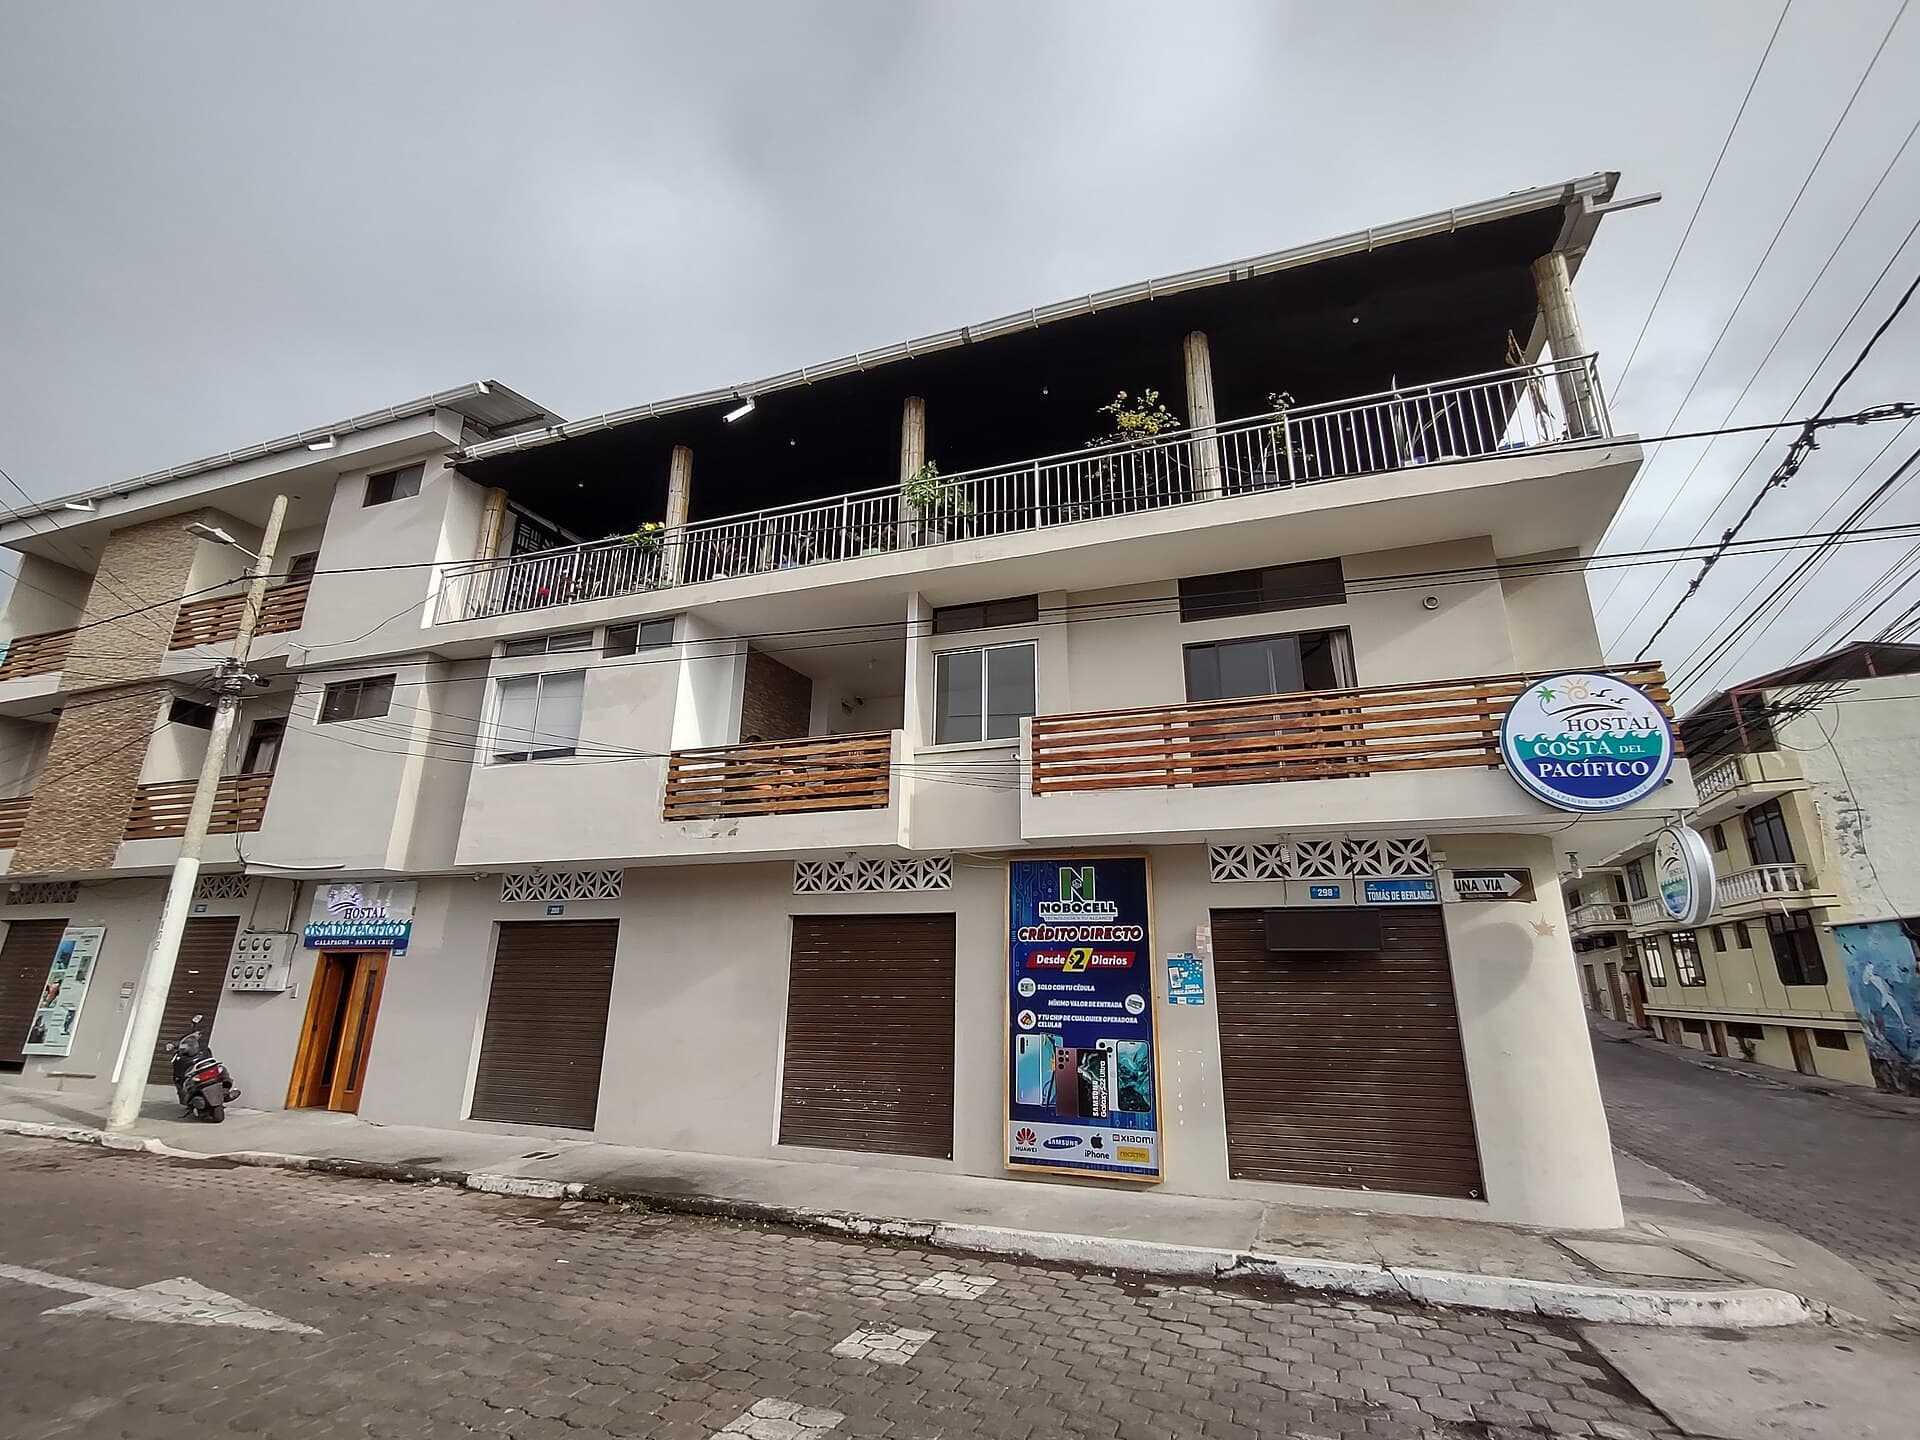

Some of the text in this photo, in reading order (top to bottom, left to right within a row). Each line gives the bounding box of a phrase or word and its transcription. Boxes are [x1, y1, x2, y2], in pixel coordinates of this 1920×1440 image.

[1567, 716, 1658, 732] HOSTAL
[1534, 740, 1646, 757] COSTA DEL
[1538, 758, 1650, 778] PACÍFICO
[1454, 879, 1503, 891] UNA VIA
[1317, 888, 1333, 897] 298
[1367, 889, 1435, 900] TOMÁS DE BERLANGA
[344, 907, 386, 919] HOSTAL
[1040, 902, 1117, 913] NOBOCELL
[1018, 924, 1143, 941] CRÉDITO DIRECTO
[1036, 954, 1066, 965] Desde
[1091, 954, 1128, 966] Diarios
[1103, 1016, 1138, 1024] OPERADORA
[1100, 1089, 1108, 1118] Galaxy
[1084, 1149, 1110, 1160] iPhone
